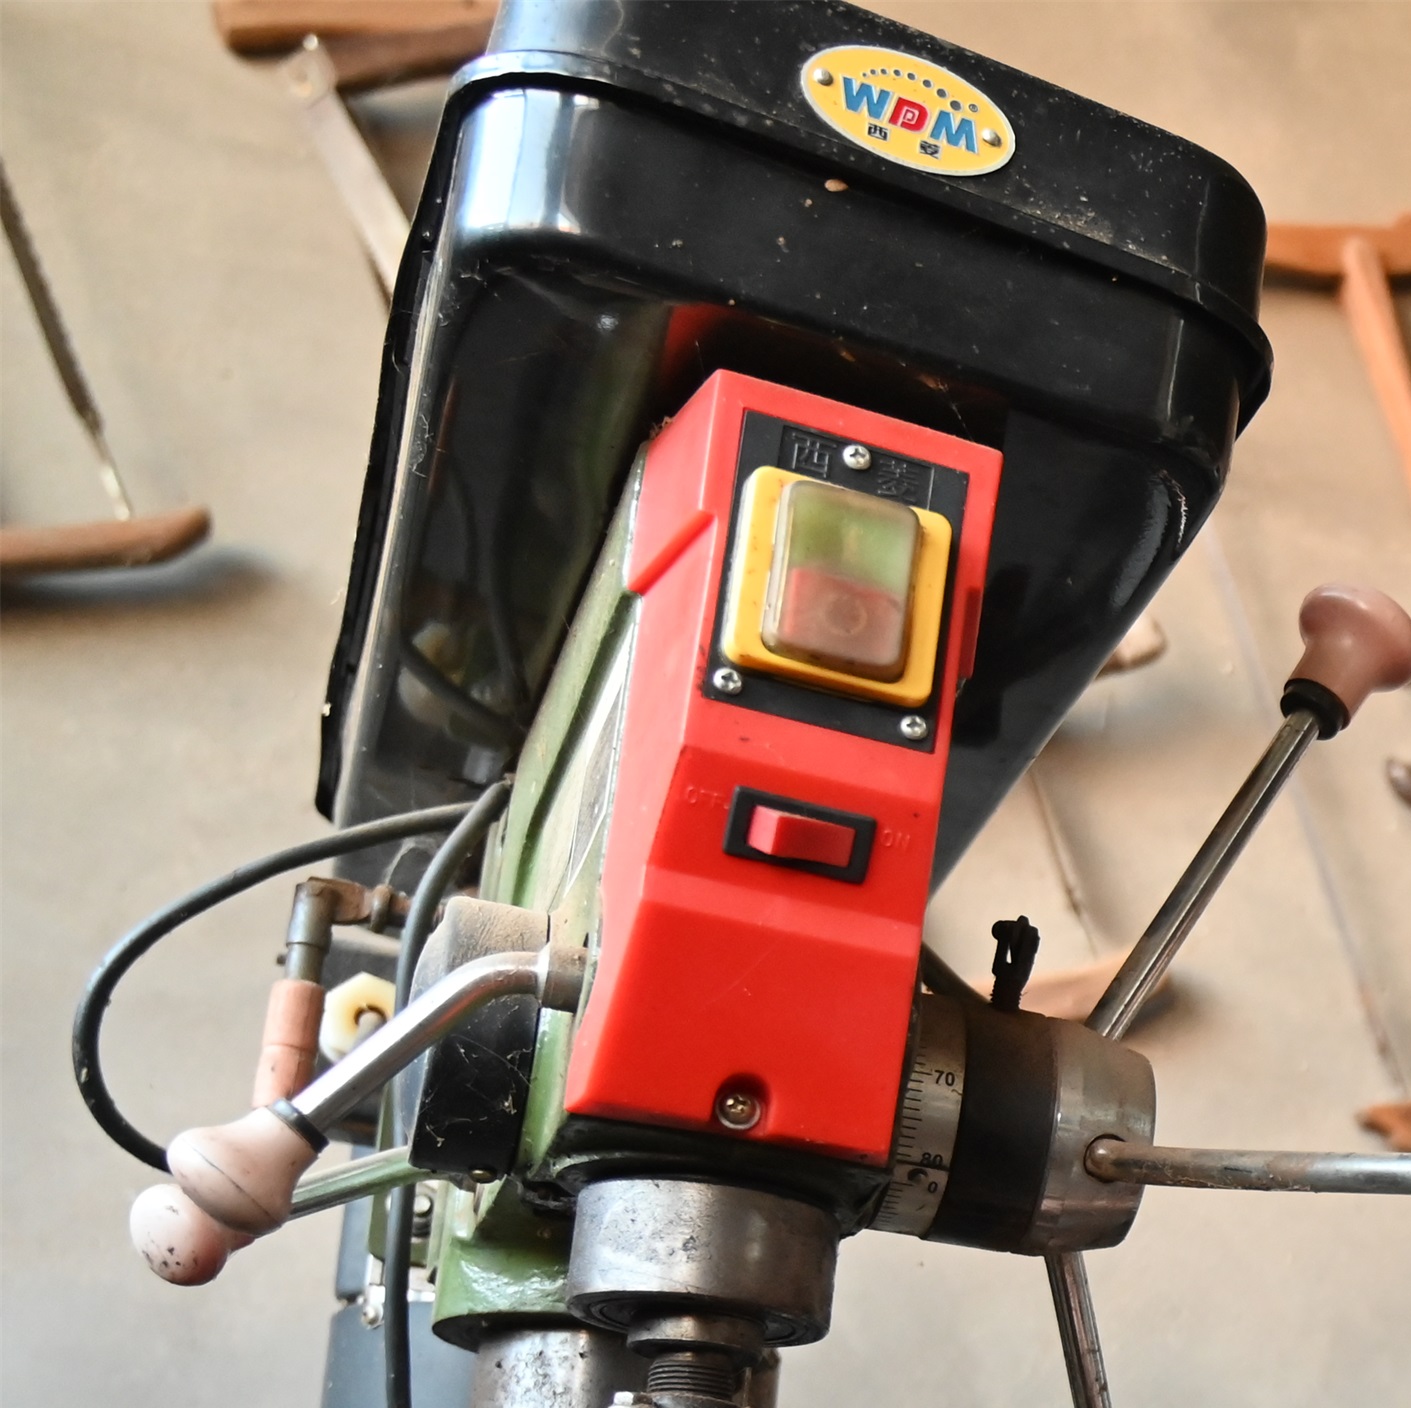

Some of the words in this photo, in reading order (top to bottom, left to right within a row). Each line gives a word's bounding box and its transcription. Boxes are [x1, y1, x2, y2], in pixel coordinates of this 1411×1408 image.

[881, 828, 911, 851] ON
[934, 1070, 956, 1087] 70
[920, 1152, 943, 1167] 80
[927, 1181, 939, 1194] 0
